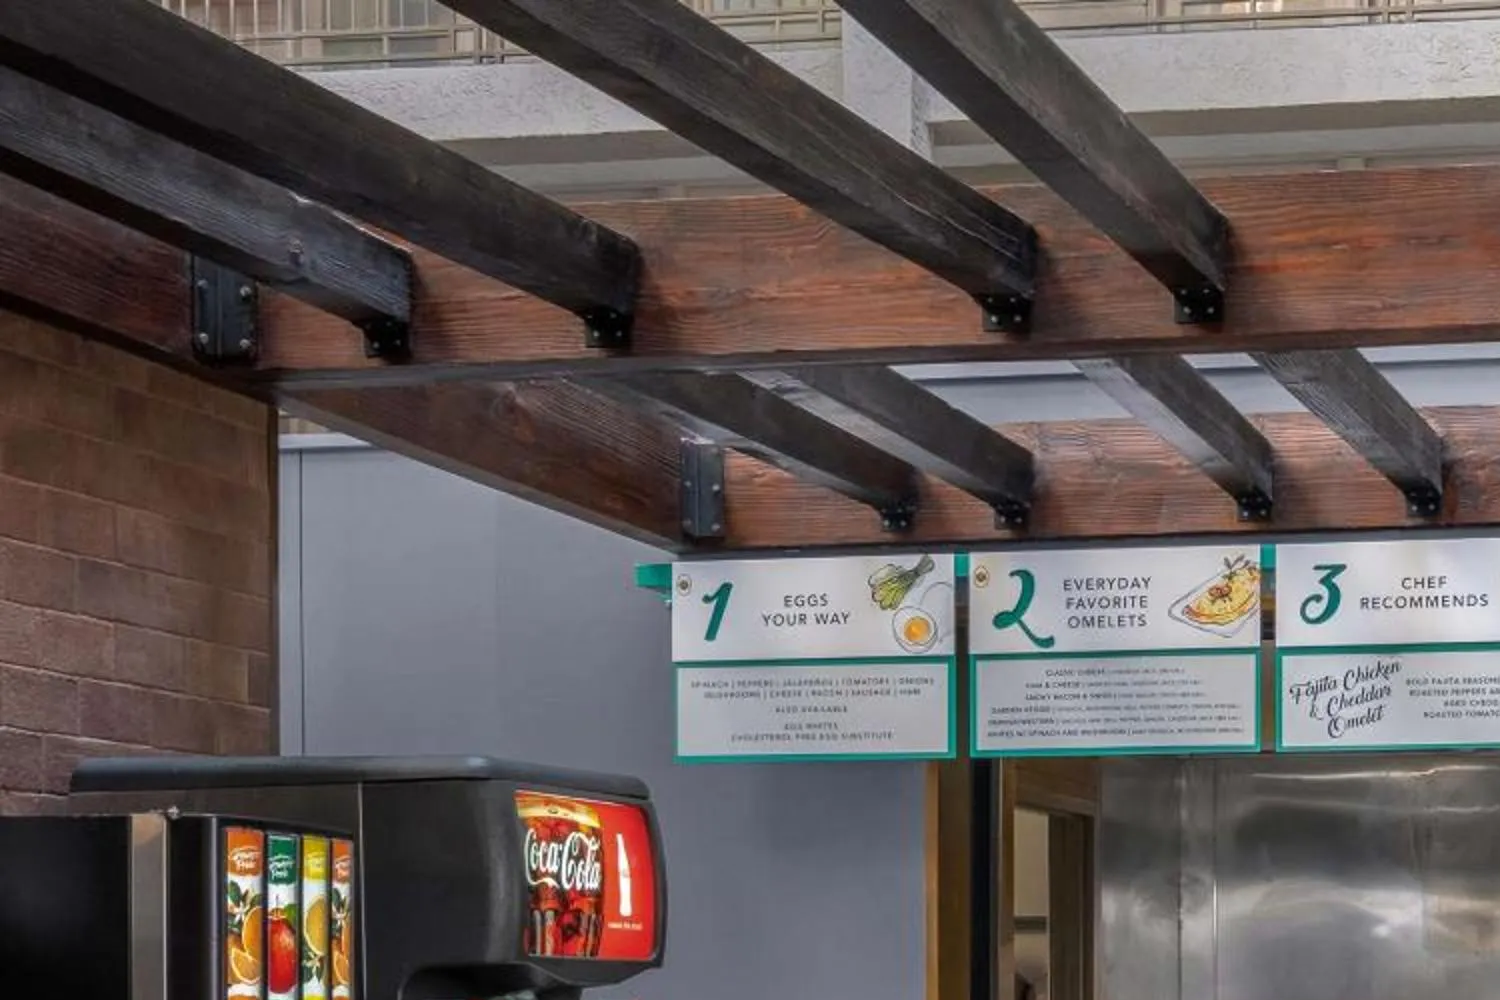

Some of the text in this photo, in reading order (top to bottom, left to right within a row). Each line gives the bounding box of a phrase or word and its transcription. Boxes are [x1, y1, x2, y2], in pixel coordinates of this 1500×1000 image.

[1062, 576, 1152, 592] EVERYDAY
[1300, 563, 1348, 626] 3
[1401, 575, 1448, 590] CHEF
[702, 581, 734, 642] 1
[783, 592, 829, 608] EGGS
[992, 568, 1056, 649] 2
[1065, 595, 1149, 610] FAVORITE
[1360, 592, 1489, 611] RECOMMENDS
[761, 611, 850, 627] YOUR WAY
[1067, 613, 1148, 629] OMELETS
[1289, 657, 1402, 705] Fajita Chicken
[1326, 682, 1392, 717] Cheddar
[1327, 702, 1385, 738] Omelet
[524, 827, 600, 890] Coca-Cola
